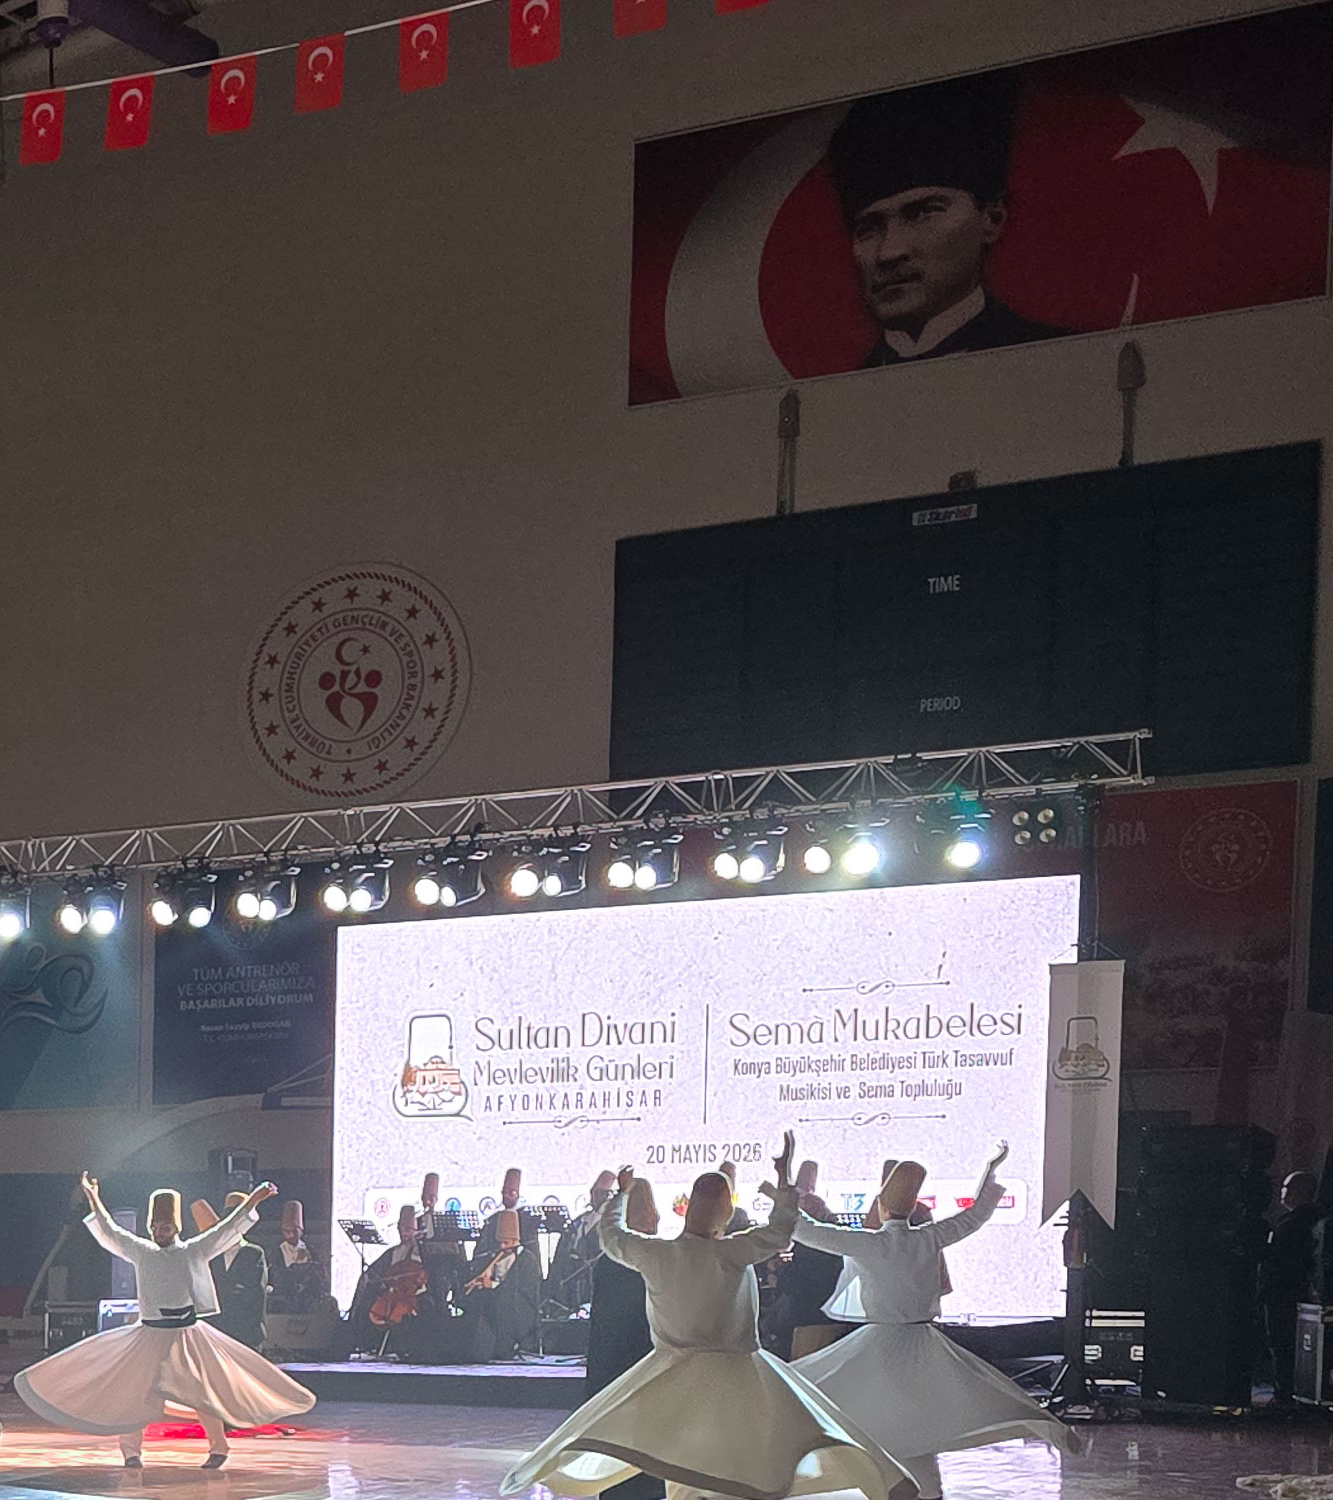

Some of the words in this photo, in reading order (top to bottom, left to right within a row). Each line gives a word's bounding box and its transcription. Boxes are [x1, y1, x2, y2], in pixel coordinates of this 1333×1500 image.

[927, 574, 962, 595] TIME
[919, 695, 962, 713] PERIOD
[474, 1015, 572, 1052] Sultan
[581, 1011, 677, 1048] Divani
[833, 1002, 1024, 1043] Mukabelesi
[473, 1055, 579, 1087] Mevlevilik
[586, 1053, 676, 1083] Günleri
[733, 1058, 772, 1079] Konya
[774, 1053, 846, 1078] Büyükşehir
[850, 1050, 918, 1074] Belediyesi
[921, 1050, 950, 1070] Türk
[952, 1048, 1015, 1068] Tasavvuf
[483, 1087, 662, 1113] AFYONKARAHİSAR
[778, 1082, 833, 1102] Musikisi
[835, 1085, 852, 1100] ve
[858, 1081, 895, 1099] Sema
[899, 1078, 963, 1101] Topluluğu
[646, 1144, 666, 1165] 20
[670, 1143, 717, 1164] MAYIS
[721, 1142, 763, 1163] 2026
